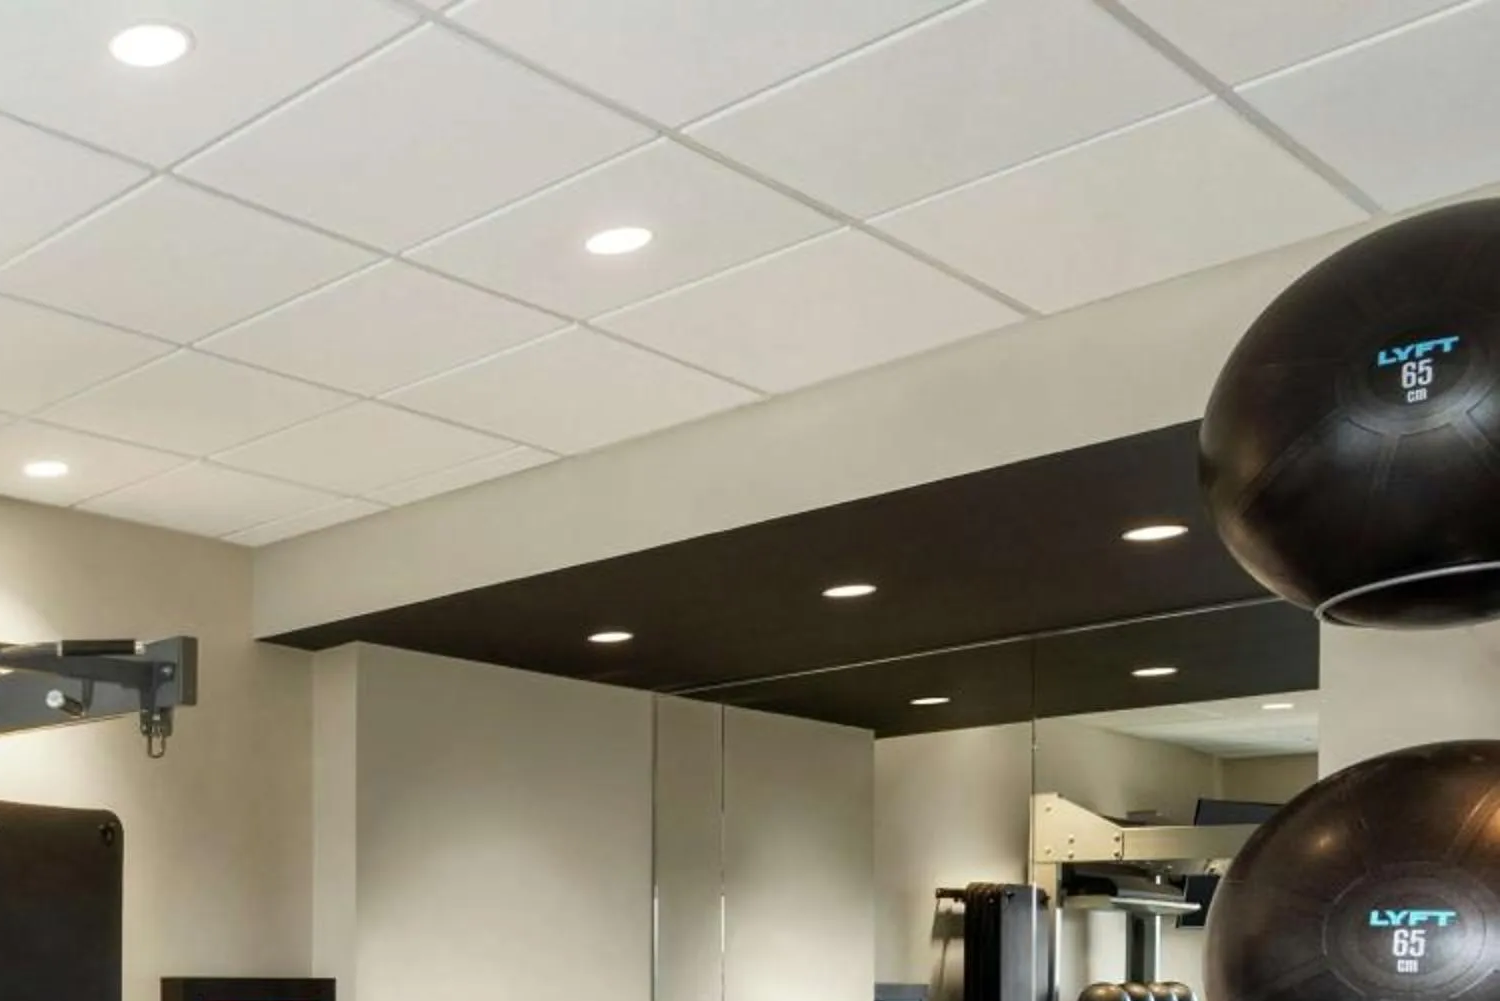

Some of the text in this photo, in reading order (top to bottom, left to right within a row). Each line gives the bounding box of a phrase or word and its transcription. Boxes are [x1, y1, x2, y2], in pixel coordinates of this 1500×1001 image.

[1377, 336, 1460, 367] LYFT
[1401, 358, 1433, 389] 65
[1368, 910, 1457, 927] LYFT
[1392, 928, 1427, 957] 65
